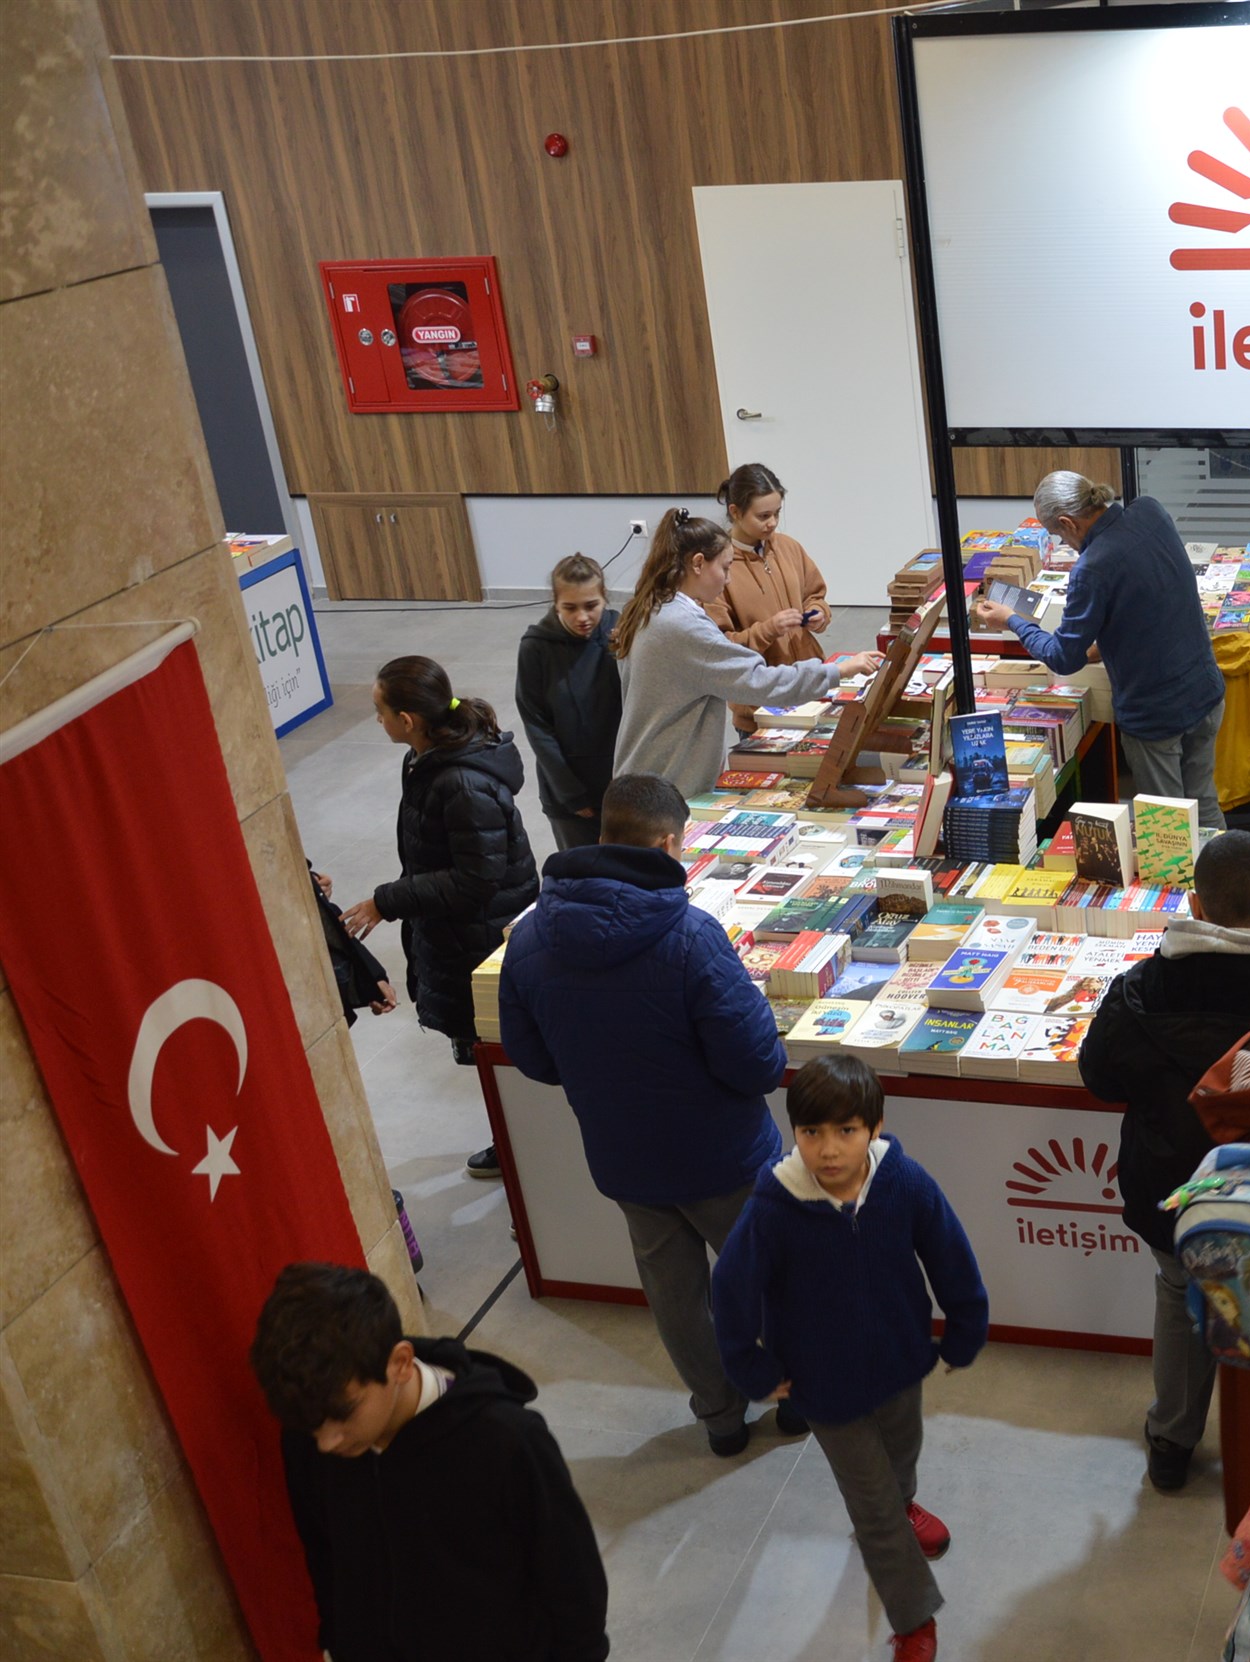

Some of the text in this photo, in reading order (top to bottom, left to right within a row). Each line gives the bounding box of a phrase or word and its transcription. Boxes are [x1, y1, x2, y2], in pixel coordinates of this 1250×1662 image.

[418, 330, 456, 340] YANGIN
[250, 603, 305, 664] itap
[1164, 833, 1188, 842] DÜNYA
[1016, 1217, 1139, 1256] iletişim
